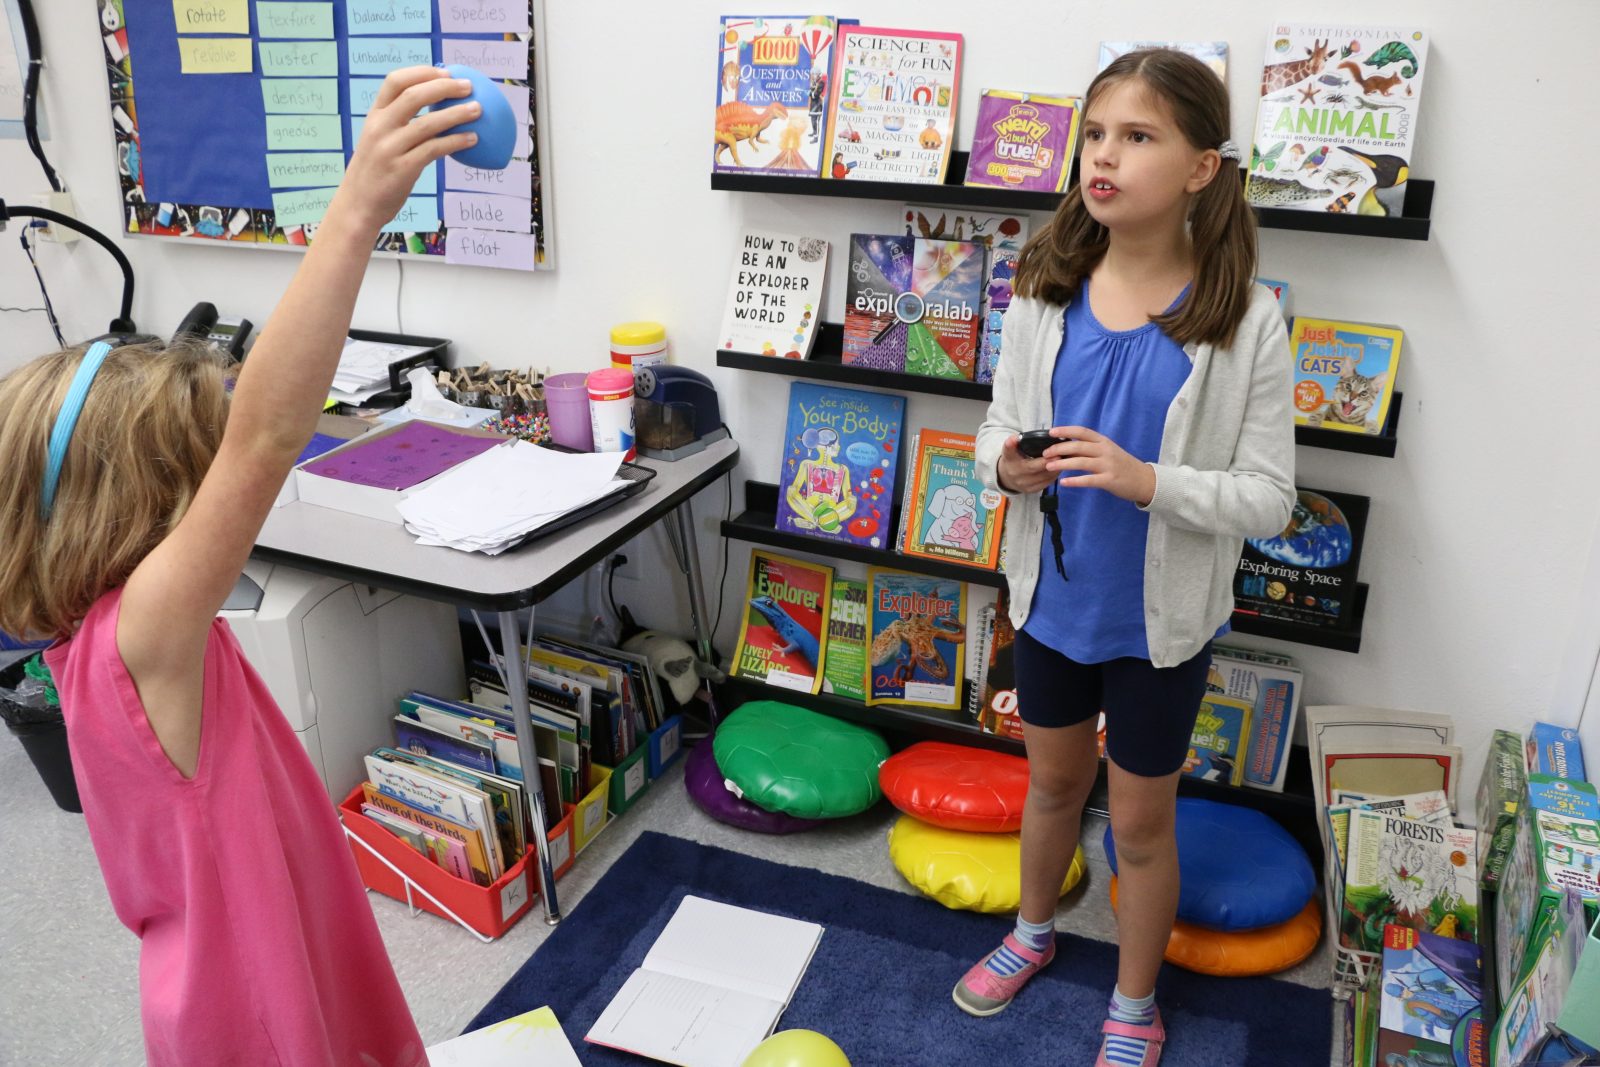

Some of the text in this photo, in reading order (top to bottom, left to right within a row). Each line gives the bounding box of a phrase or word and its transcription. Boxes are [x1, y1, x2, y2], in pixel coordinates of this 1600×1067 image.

[186, 8, 226, 23] rotate
[268, 9, 316, 27] texture
[352, 7, 427, 25] balanced force
[1298, 27, 1403, 40] SMITHSONIAN
[754, 39, 797, 60] 1000
[847, 36, 930, 54] SCIENCE
[193, 46, 238, 63] revolve
[268, 51, 320, 66] luster
[408, 50, 430, 64] force
[898, 55, 952, 72] for FUN
[740, 64, 810, 82] QUESTIONS
[765, 81, 782, 89] and
[272, 86, 324, 110] density
[743, 86, 802, 102] ANSWERS
[867, 103, 884, 112] with
[838, 114, 878, 125] PROJECTS
[1262, 106, 1273, 131] THE
[1273, 107, 1395, 140] ANIMAL
[1396, 113, 1411, 141] BOOK
[273, 125, 318, 142] igneous
[865, 130, 914, 144] MAGNETS
[1012, 133, 1025, 143] but
[1270, 131, 1293, 141] visual
[1294, 134, 1345, 146] encyclopedia
[1347, 137, 1356, 145] of
[1357, 138, 1371, 146] life
[1384, 140, 1406, 149] Earth
[833, 143, 942, 162] SOUND LIGHT
[997, 139, 1039, 161] true!
[273, 163, 340, 177] metamorphic
[858, 160, 920, 174] ELECTRICITY
[464, 169, 504, 183] stipe
[459, 201, 504, 222] blade
[461, 236, 501, 256] float
[745, 235, 794, 253] HOW TO
[742, 252, 787, 269] BE AN
[738, 271, 809, 291] EXPLORER
[736, 290, 787, 307] OF THE
[735, 307, 785, 324] WORLD
[1299, 326, 1334, 341] Just
[1301, 358, 1341, 374] CATS
[819, 396, 870, 413] See inside
[800, 402, 888, 441] Your Body
[933, 463, 968, 479] Thank
[956, 460, 969, 468] The
[950, 477, 968, 486] Book
[945, 548, 969, 559] Willems
[1239, 558, 1342, 586] Exploring Space
[758, 572, 820, 609] Explorer
[879, 589, 954, 618] Explorer
[744, 644, 774, 660] LIVELY
[1216, 738, 1227, 752] 5
[1548, 805, 1585, 817] Includes
[1557, 801, 1575, 811] 16
[371, 795, 467, 843] King of the Birds
[1385, 818, 1444, 844] FORESTS
[1488, 865, 1500, 881] Into
[1554, 872, 1582, 883] Folder
